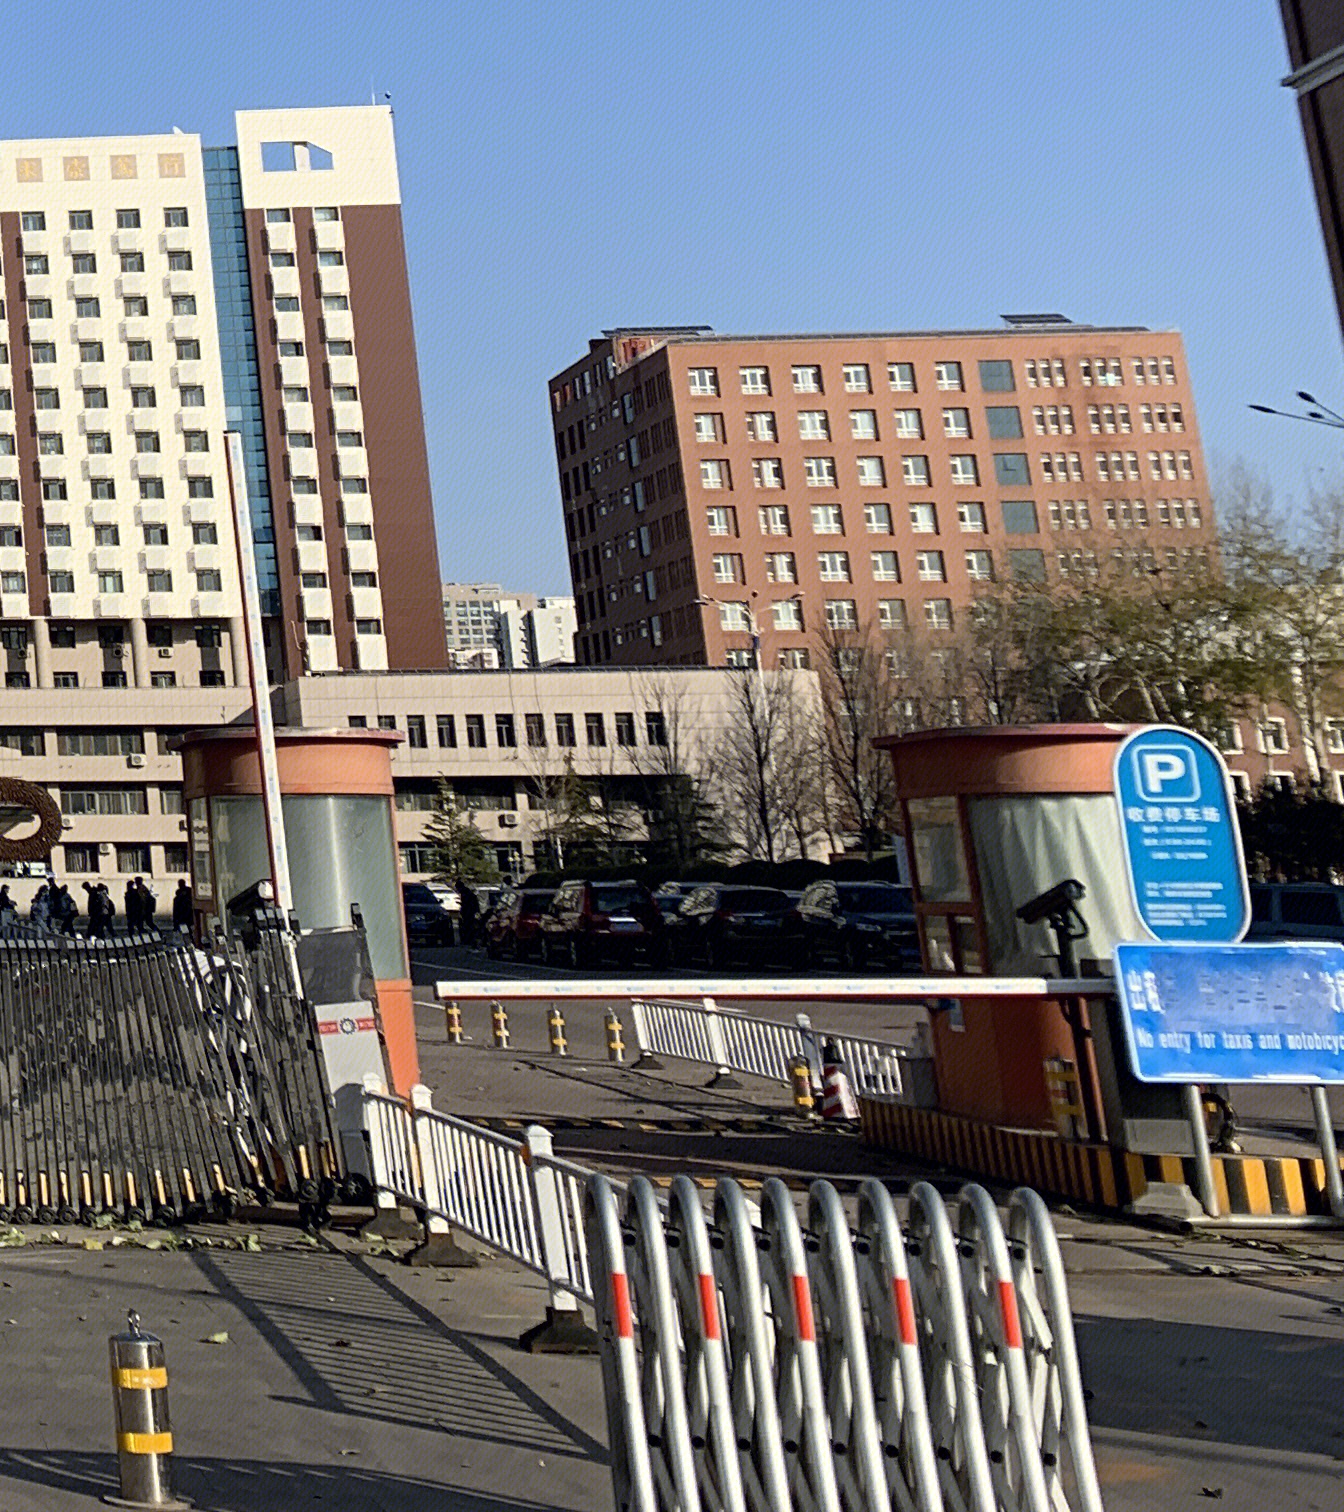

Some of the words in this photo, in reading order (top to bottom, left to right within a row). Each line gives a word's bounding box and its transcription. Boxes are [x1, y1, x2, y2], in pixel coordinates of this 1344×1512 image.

[1143, 753, 1186, 794] P
[1136, 1028, 1154, 1049] No
[1159, 1030, 1192, 1054] entry
[1197, 1030, 1216, 1049] for
[1222, 1031, 1254, 1050] taxis
[1259, 1031, 1282, 1050] and
